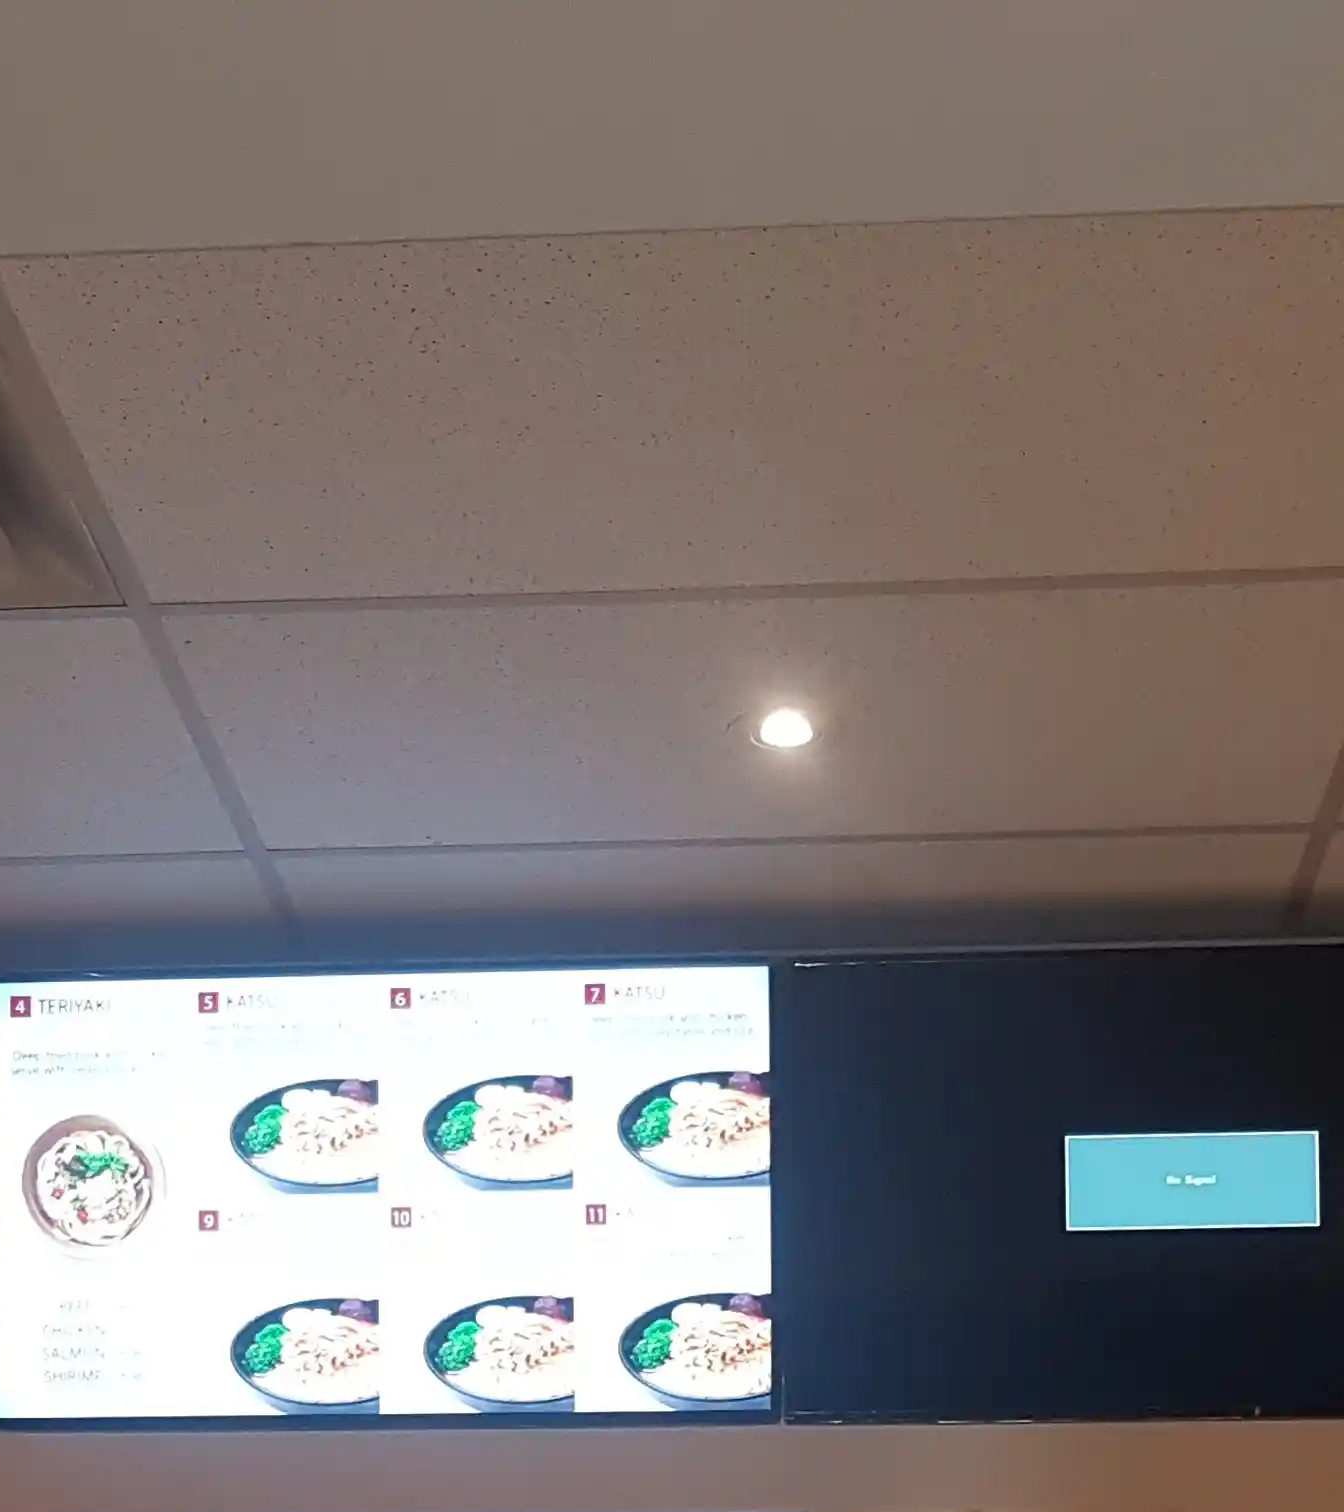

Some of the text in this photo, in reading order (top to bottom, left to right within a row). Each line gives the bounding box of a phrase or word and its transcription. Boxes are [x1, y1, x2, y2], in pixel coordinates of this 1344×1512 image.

[38, 998, 112, 1015] TERIYAKI
[391, 1209, 411, 1227] 10
[588, 1206, 605, 1223] 11
